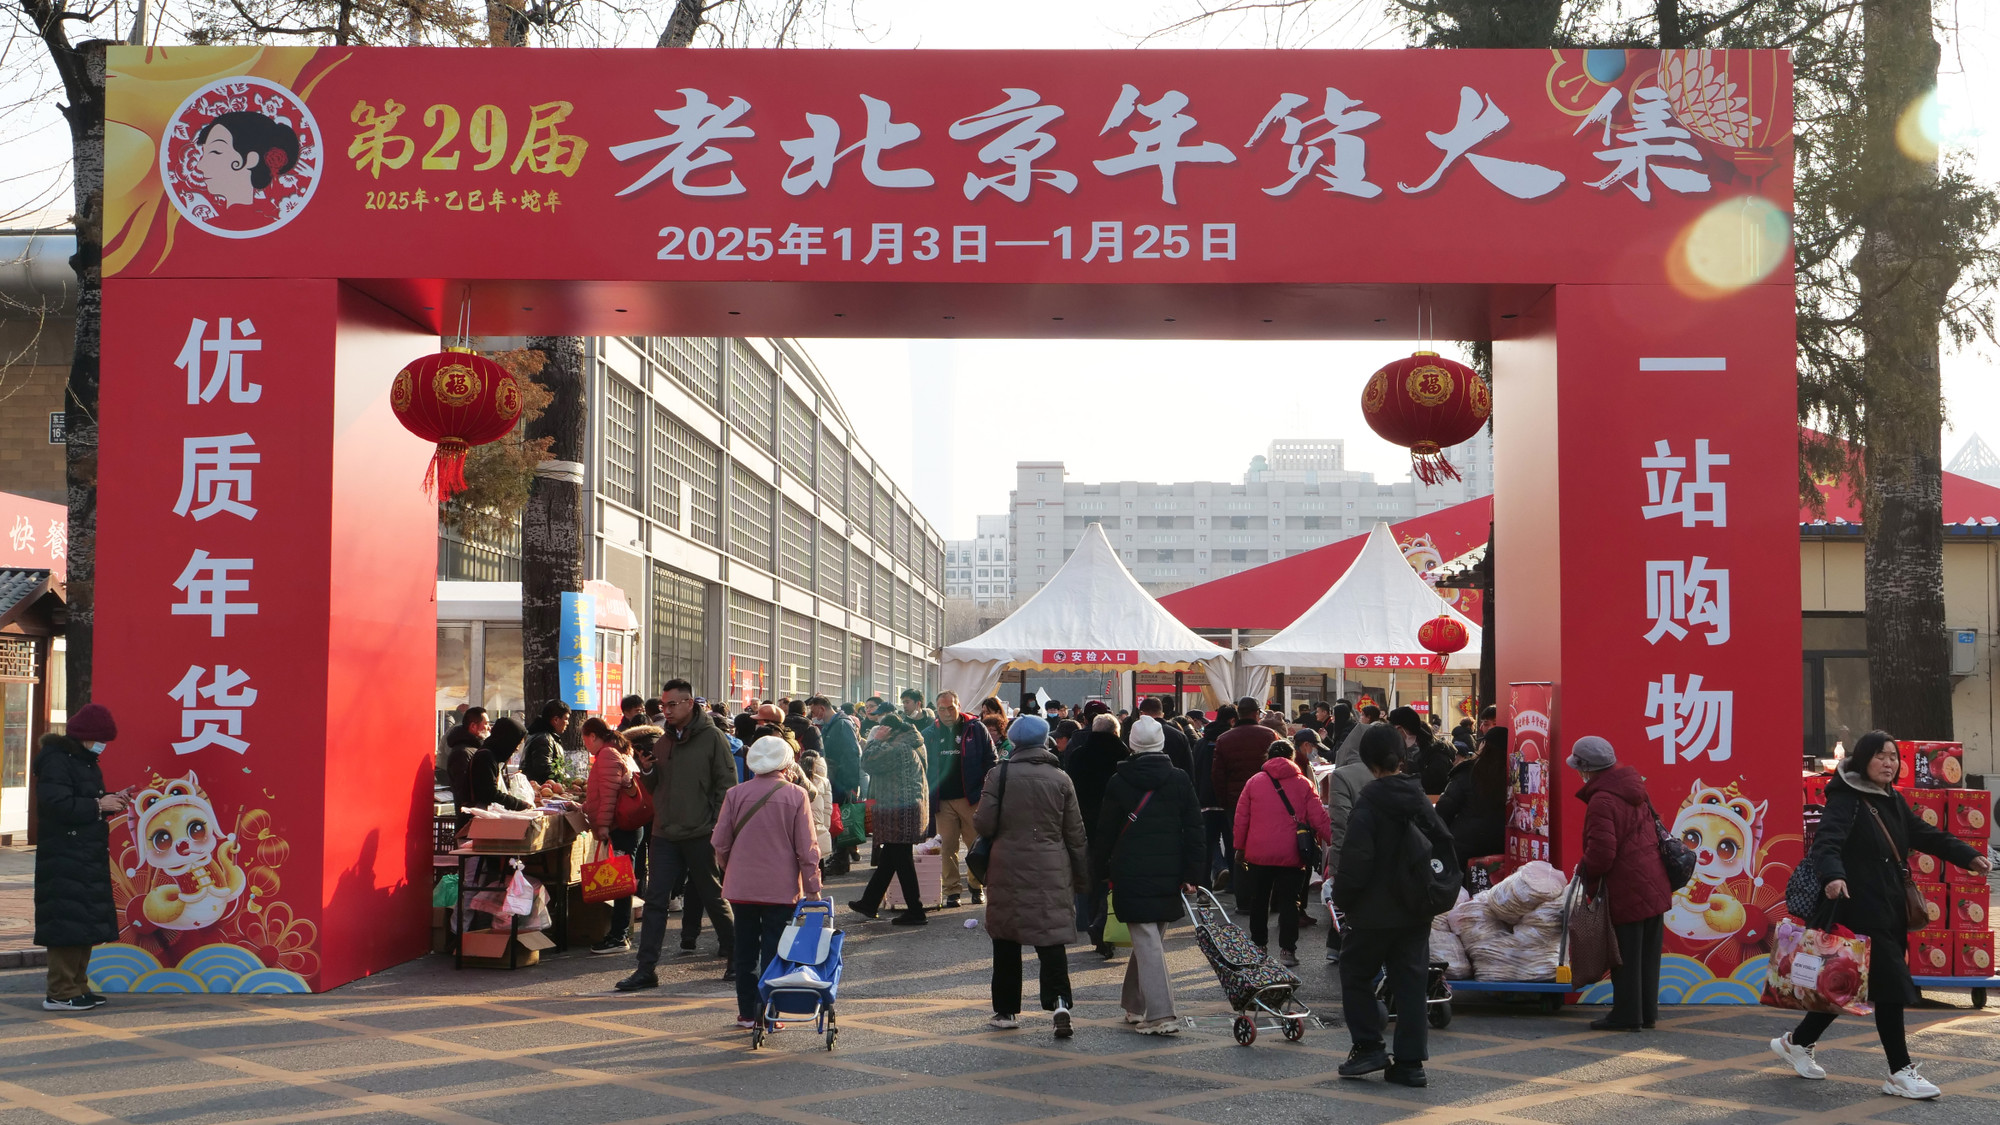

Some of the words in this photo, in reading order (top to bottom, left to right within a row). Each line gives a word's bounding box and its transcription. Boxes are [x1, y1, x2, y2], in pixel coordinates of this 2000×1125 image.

[347, 97, 590, 180] 第29届
[608, 83, 1711, 206] 老北京年货大集
[445, 373, 469, 395] 福
[1418, 373, 1442, 396] 福
[9, 515, 68, 560] 快餐
[168, 317, 263, 756] 优质年货
[1639, 357, 1734, 765] 一站购物
[1071, 651, 1126, 662] 安检入口
[1373, 656, 1430, 666] 安检入口
